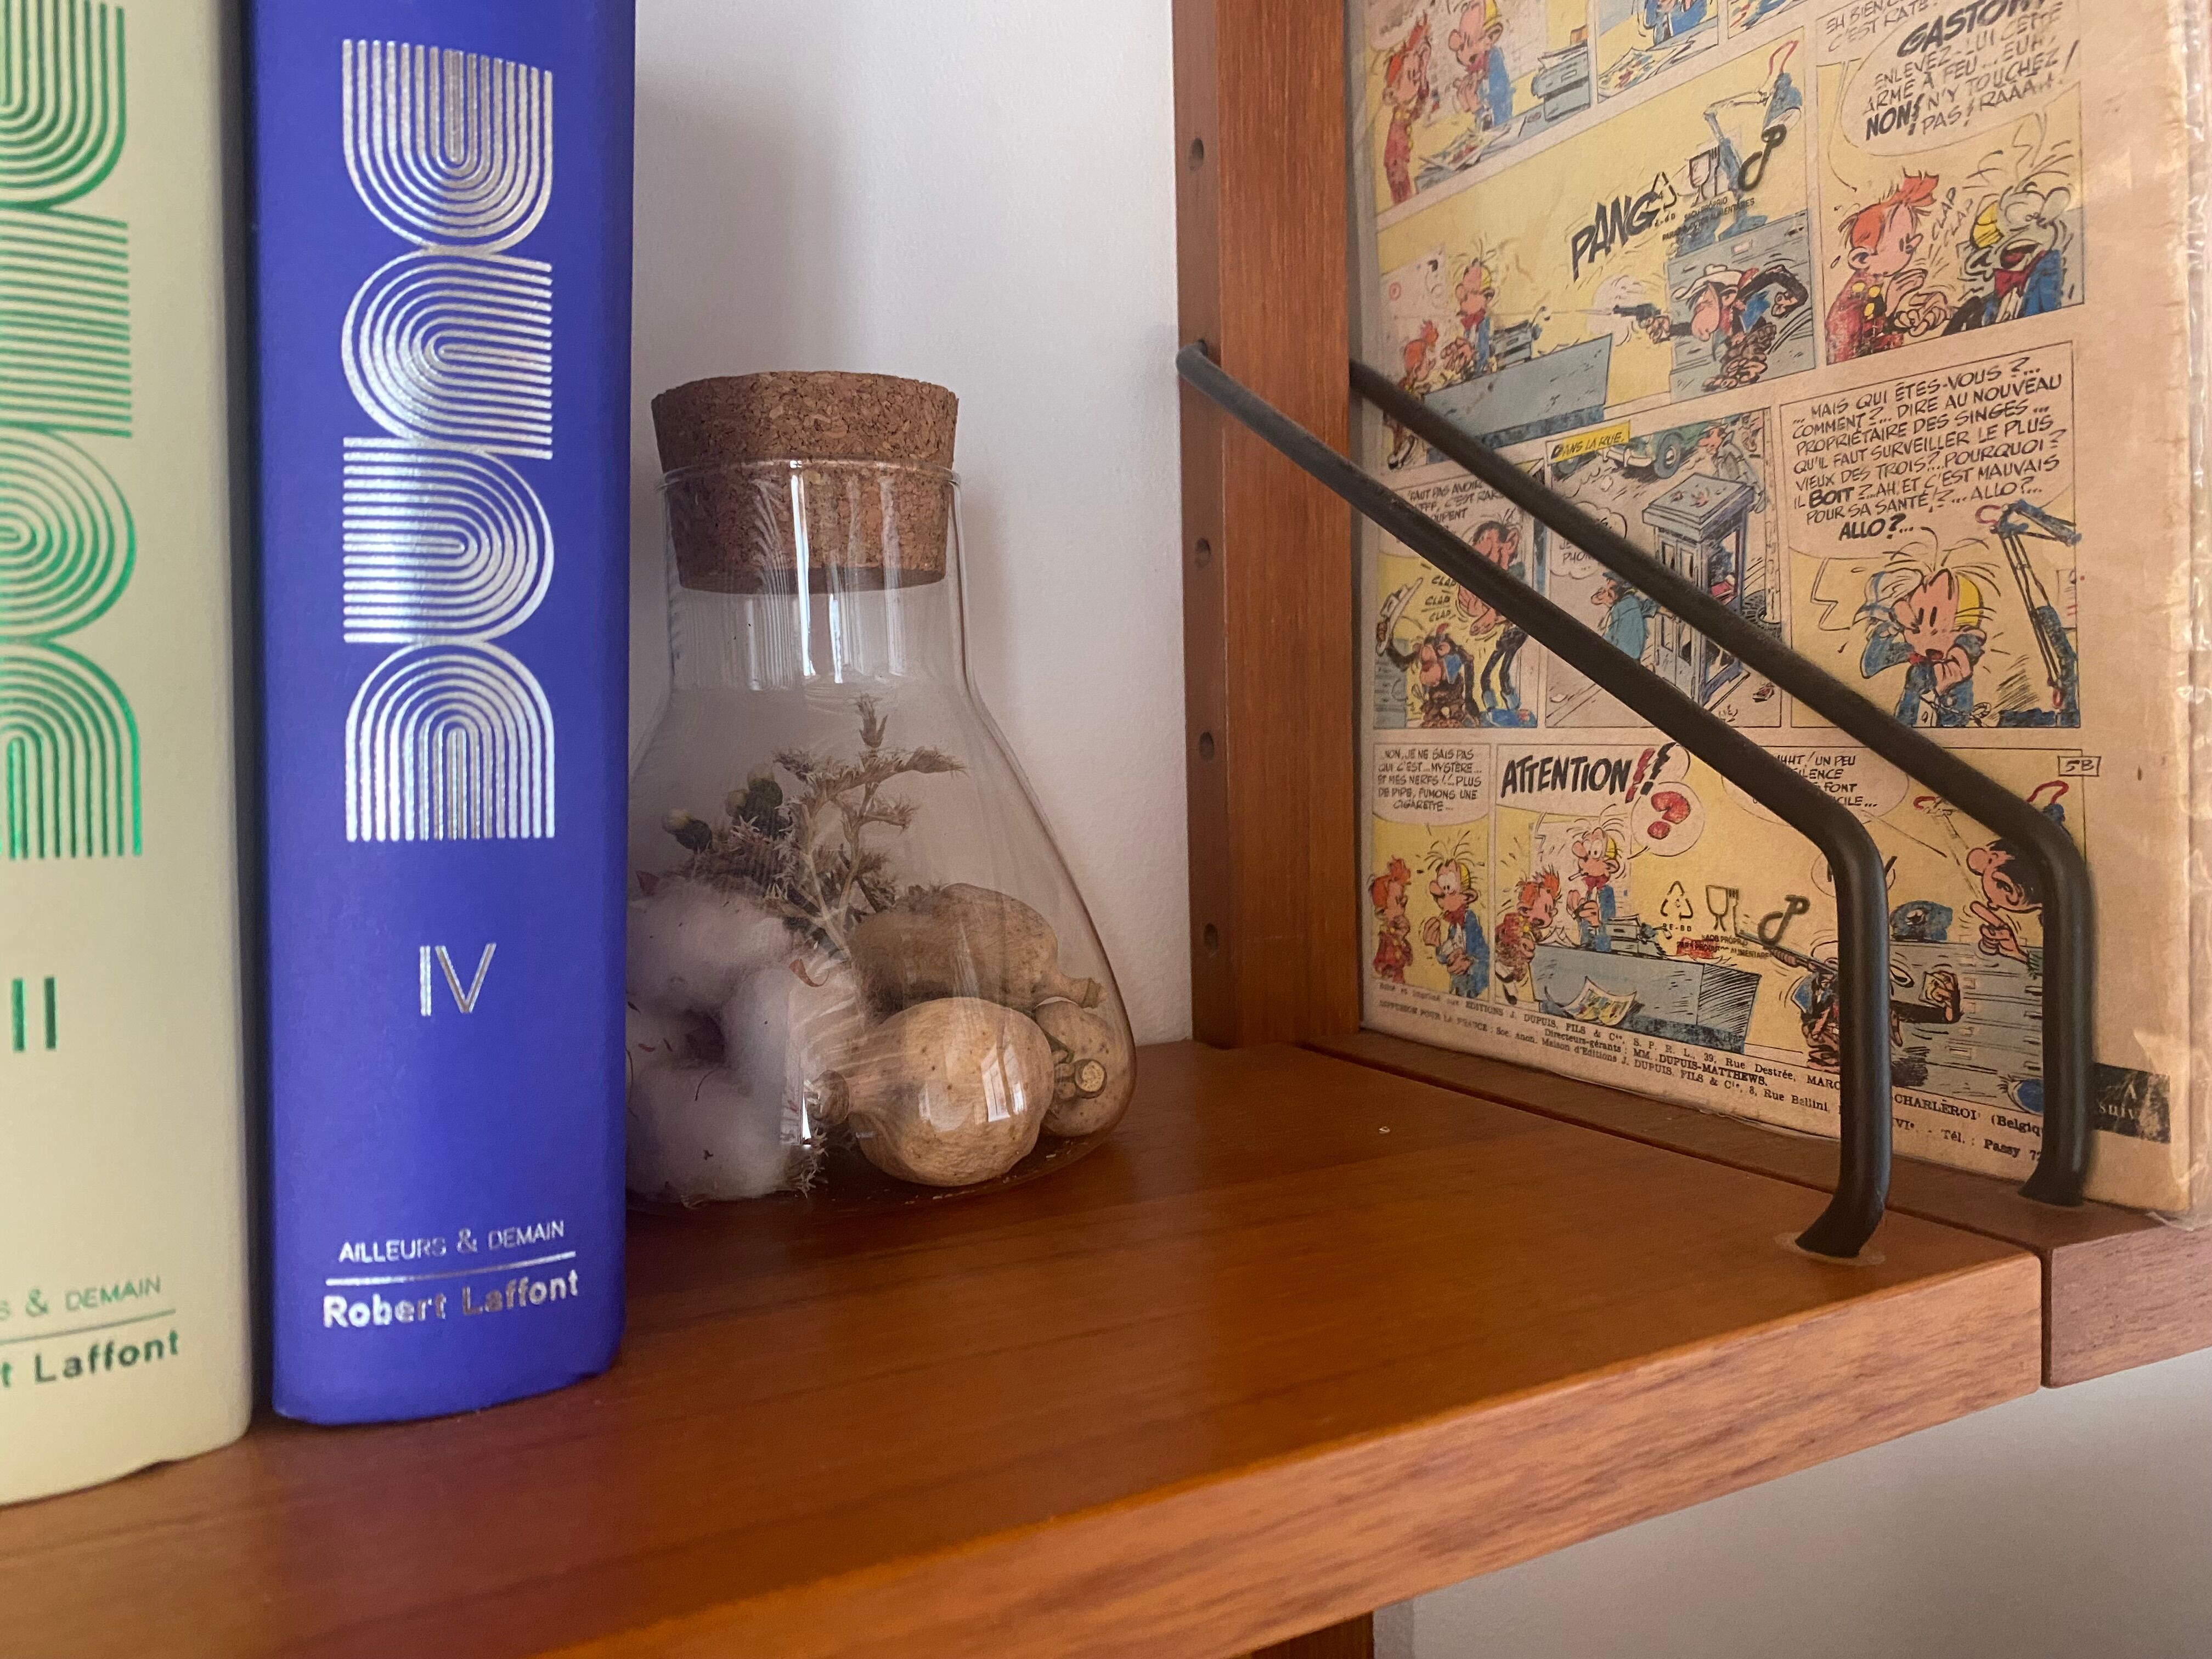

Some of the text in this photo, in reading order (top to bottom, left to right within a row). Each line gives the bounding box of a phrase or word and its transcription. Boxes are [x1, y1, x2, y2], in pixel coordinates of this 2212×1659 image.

[1811, 398, 1849, 419] MAIS
[1856, 390, 1888, 409] QUI
[1897, 397, 1939, 418] DIRE
[1945, 392, 1968, 409] AU
[1973, 374, 2062, 404] NOUVEAU
[1913, 414, 1949, 434] DES
[1954, 398, 2029, 427] SINGES
[1551, 441, 1583, 459] DANS
[1585, 439, 1596, 450] LA
[1793, 415, 2054, 475] QU'IL FAUT SURVEILLER LE PLUS
[1795, 473, 1835, 492] VIEUX
[1840, 467, 1871, 483] DES
[1944, 438, 2043, 467] POURQUOI
[1794, 497, 1806, 510] IL
[1809, 487, 1855, 509] BOIT
[1902, 477, 1921, 493] ET
[1978, 454, 2061, 482] MAUVAIS
[1806, 506, 1845, 525] POUR
[1847, 502, 1871, 519] SA
[1378, 763, 1393, 772] QUI
[1418, 748, 1429, 760] NE
[1432, 747, 1454, 760] SAIS
[1456, 748, 1475, 760] PAS
[1815, 756, 1831, 766] UN
[1835, 755, 1856, 767] PEU
[1419, 787, 1455, 800] FUMONS
[1459, 789, 1478, 800] UNE
[1455, 776, 1482, 787] PLUS
[1824, 781, 1858, 793] FONT
[419, 941, 498, 1017] IV
[1565, 1022, 1587, 1035] FILS
[1725, 1057, 1746, 1070] Rue
[1542, 1037, 1571, 1052] Maison
[1680, 1069, 1704, 1084] FILS
[1763, 1088, 1785, 1102] Rue
[1983, 1138, 2021, 1159] Passy
[338, 1219, 565, 1263] AILLEURS & DEMAIN
[25, 1288, 48, 1318] &
[65, 1274, 162, 1312] DEMAIN
[323, 1268, 579, 1329] Robert Laffont
[33, 1328, 179, 1384] Laffont
